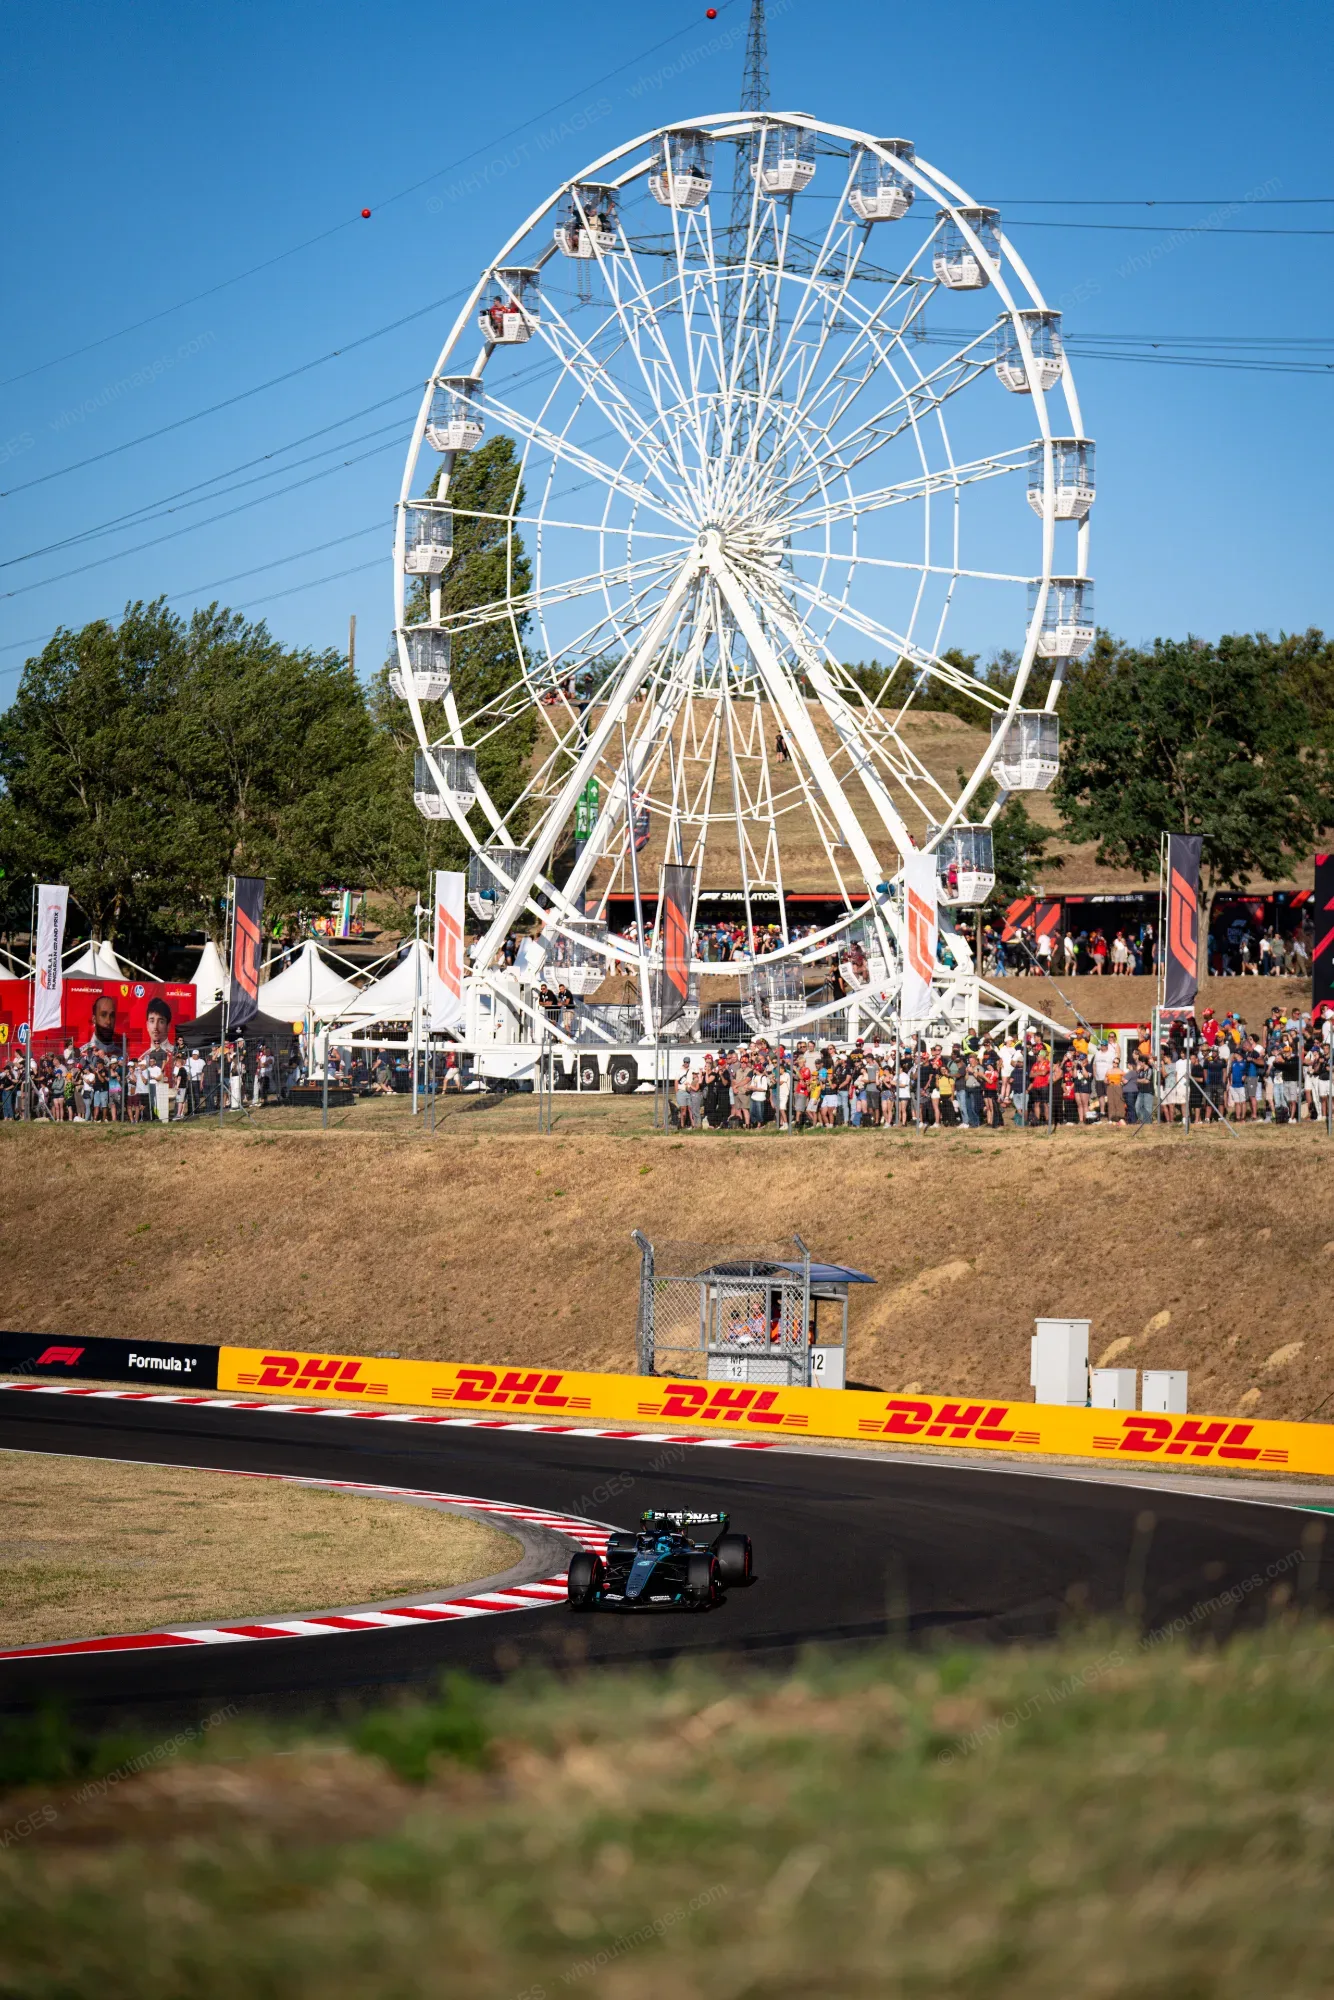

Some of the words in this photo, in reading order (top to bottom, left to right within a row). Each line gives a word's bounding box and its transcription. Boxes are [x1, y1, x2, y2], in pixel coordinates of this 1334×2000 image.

[720, 892, 780, 901] SIMUATORS
[128, 1353, 182, 1371] Formula
[258, 1357, 367, 1392] DHL
[731, 1366, 742, 1377] 12
[811, 1354, 824, 1370] 12
[453, 1370, 568, 1406] DHL
[661, 1385, 784, 1424] DHL
[883, 1401, 1014, 1441] DHL
[1119, 1418, 1261, 1460] DHL
